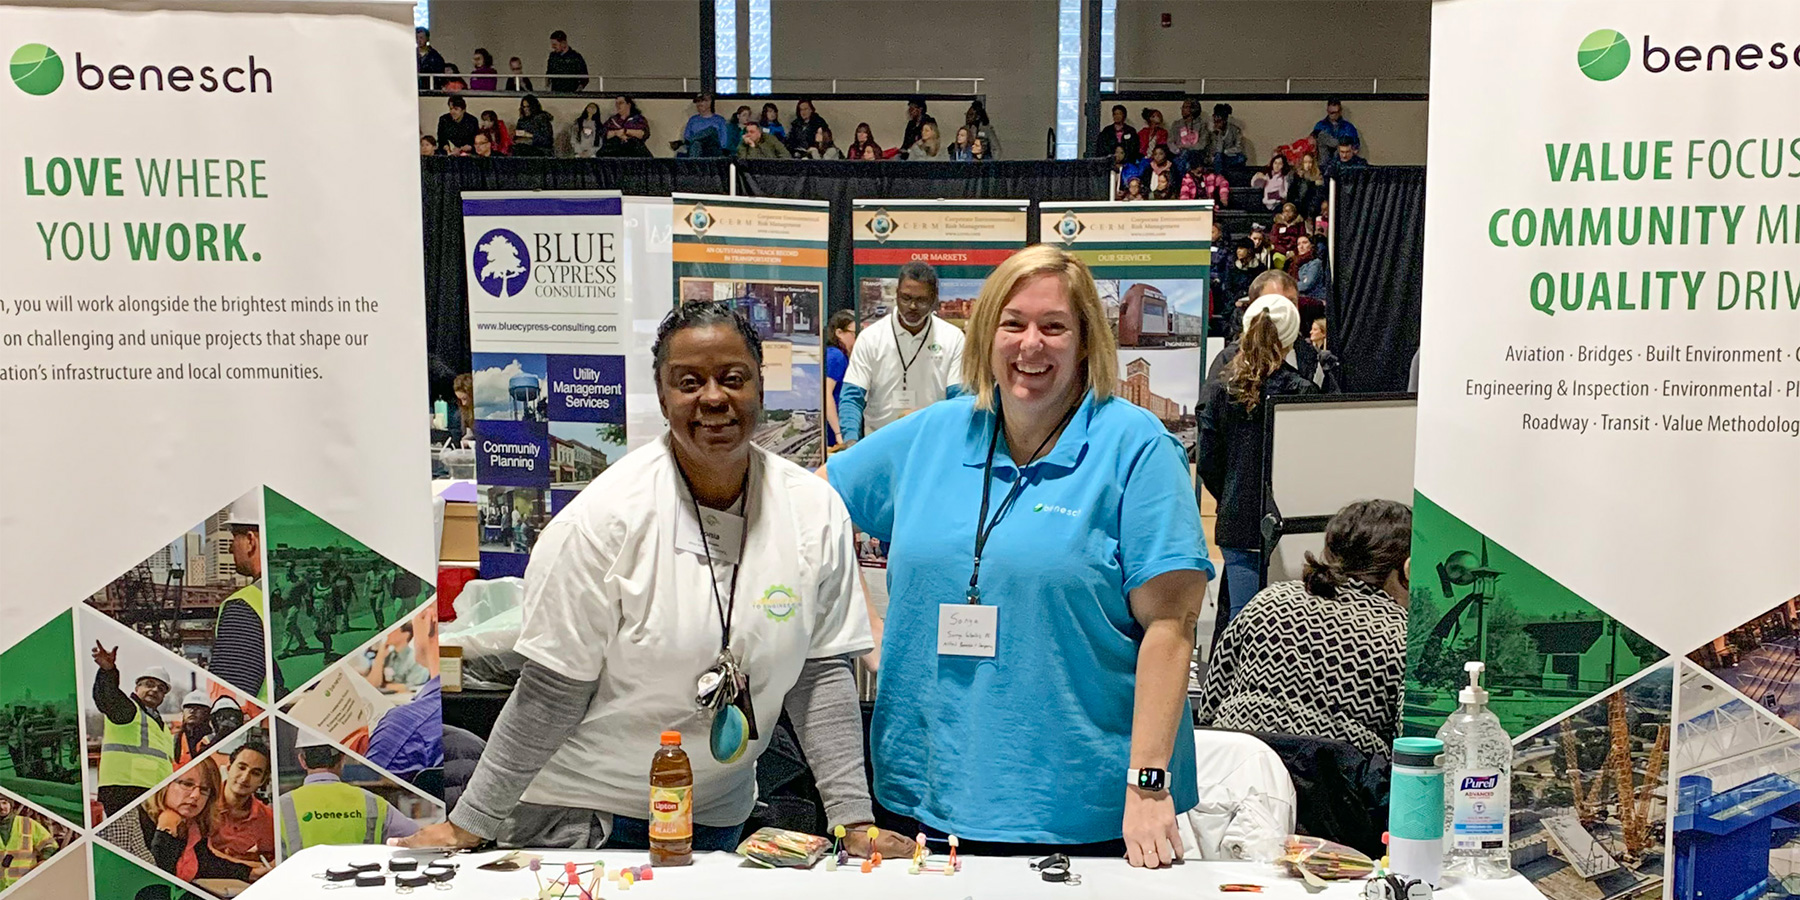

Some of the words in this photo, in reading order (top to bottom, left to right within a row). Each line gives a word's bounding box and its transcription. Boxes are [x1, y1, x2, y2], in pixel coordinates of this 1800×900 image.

[75, 51, 273, 93] benesch
[1545, 140, 1673, 182] VALUE
[24, 156, 124, 197] LOVE
[135, 157, 268, 198] WHERE
[1488, 204, 1746, 247] COMMUNITY
[36, 221, 111, 261] YOU
[123, 222, 262, 262] WORK.
[533, 232, 616, 264] BLUE
[911, 253, 929, 261] OUR
[930, 253, 967, 261] MARKETS
[1098, 254, 1115, 262] OUR
[1116, 254, 1151, 262] SERVICES
[534, 264, 617, 285] CYPRESS
[535, 285, 616, 299] CONSULTING
[1529, 270, 1706, 317] QUALITY
[14, 299, 41, 316] you
[46, 295, 73, 311] will
[77, 295, 114, 311] work
[118, 295, 190, 316] alongside
[194, 296, 217, 312] the
[221, 296, 287, 316] brightest
[291, 296, 334, 312] minds
[338, 297, 351, 312] in
[355, 297, 379, 312] the
[477, 322, 617, 334] www.bluecypress-consulting.com
[3, 333, 22, 346] on
[27, 330, 114, 350] challenging
[118, 330, 146, 346] and
[150, 330, 201, 350] unique
[205, 330, 262, 350] projects
[266, 330, 295, 346] that
[300, 330, 341, 350] shape
[345, 333, 369, 346] our
[1505, 345, 1565, 362] Aviation
[1578, 345, 1633, 366] Bridges
[1646, 345, 1681, 362] Built
[1686, 345, 1783, 363] Environment
[51, 364, 153, 380] infrastructure
[156, 364, 184, 379] and
[188, 363, 222, 379] local
[225, 364, 323, 379] communities.
[573, 368, 601, 382] Utility
[553, 381, 622, 396] Management
[1466, 379, 1553, 400] Engineering
[1557, 380, 1568, 396] &
[1573, 380, 1649, 400] Inspection
[1663, 380, 1772, 397] Environmental
[565, 396, 610, 409] Services
[1522, 413, 1589, 434] Roadway
[1601, 414, 1650, 431] Transit
[1662, 414, 1703, 431] Value
[483, 440, 541, 456] Community
[490, 455, 534, 471] Planning
[1464, 777, 1496, 789] Purell
[314, 810, 362, 820] benesch
[655, 802, 677, 810] Lipton
